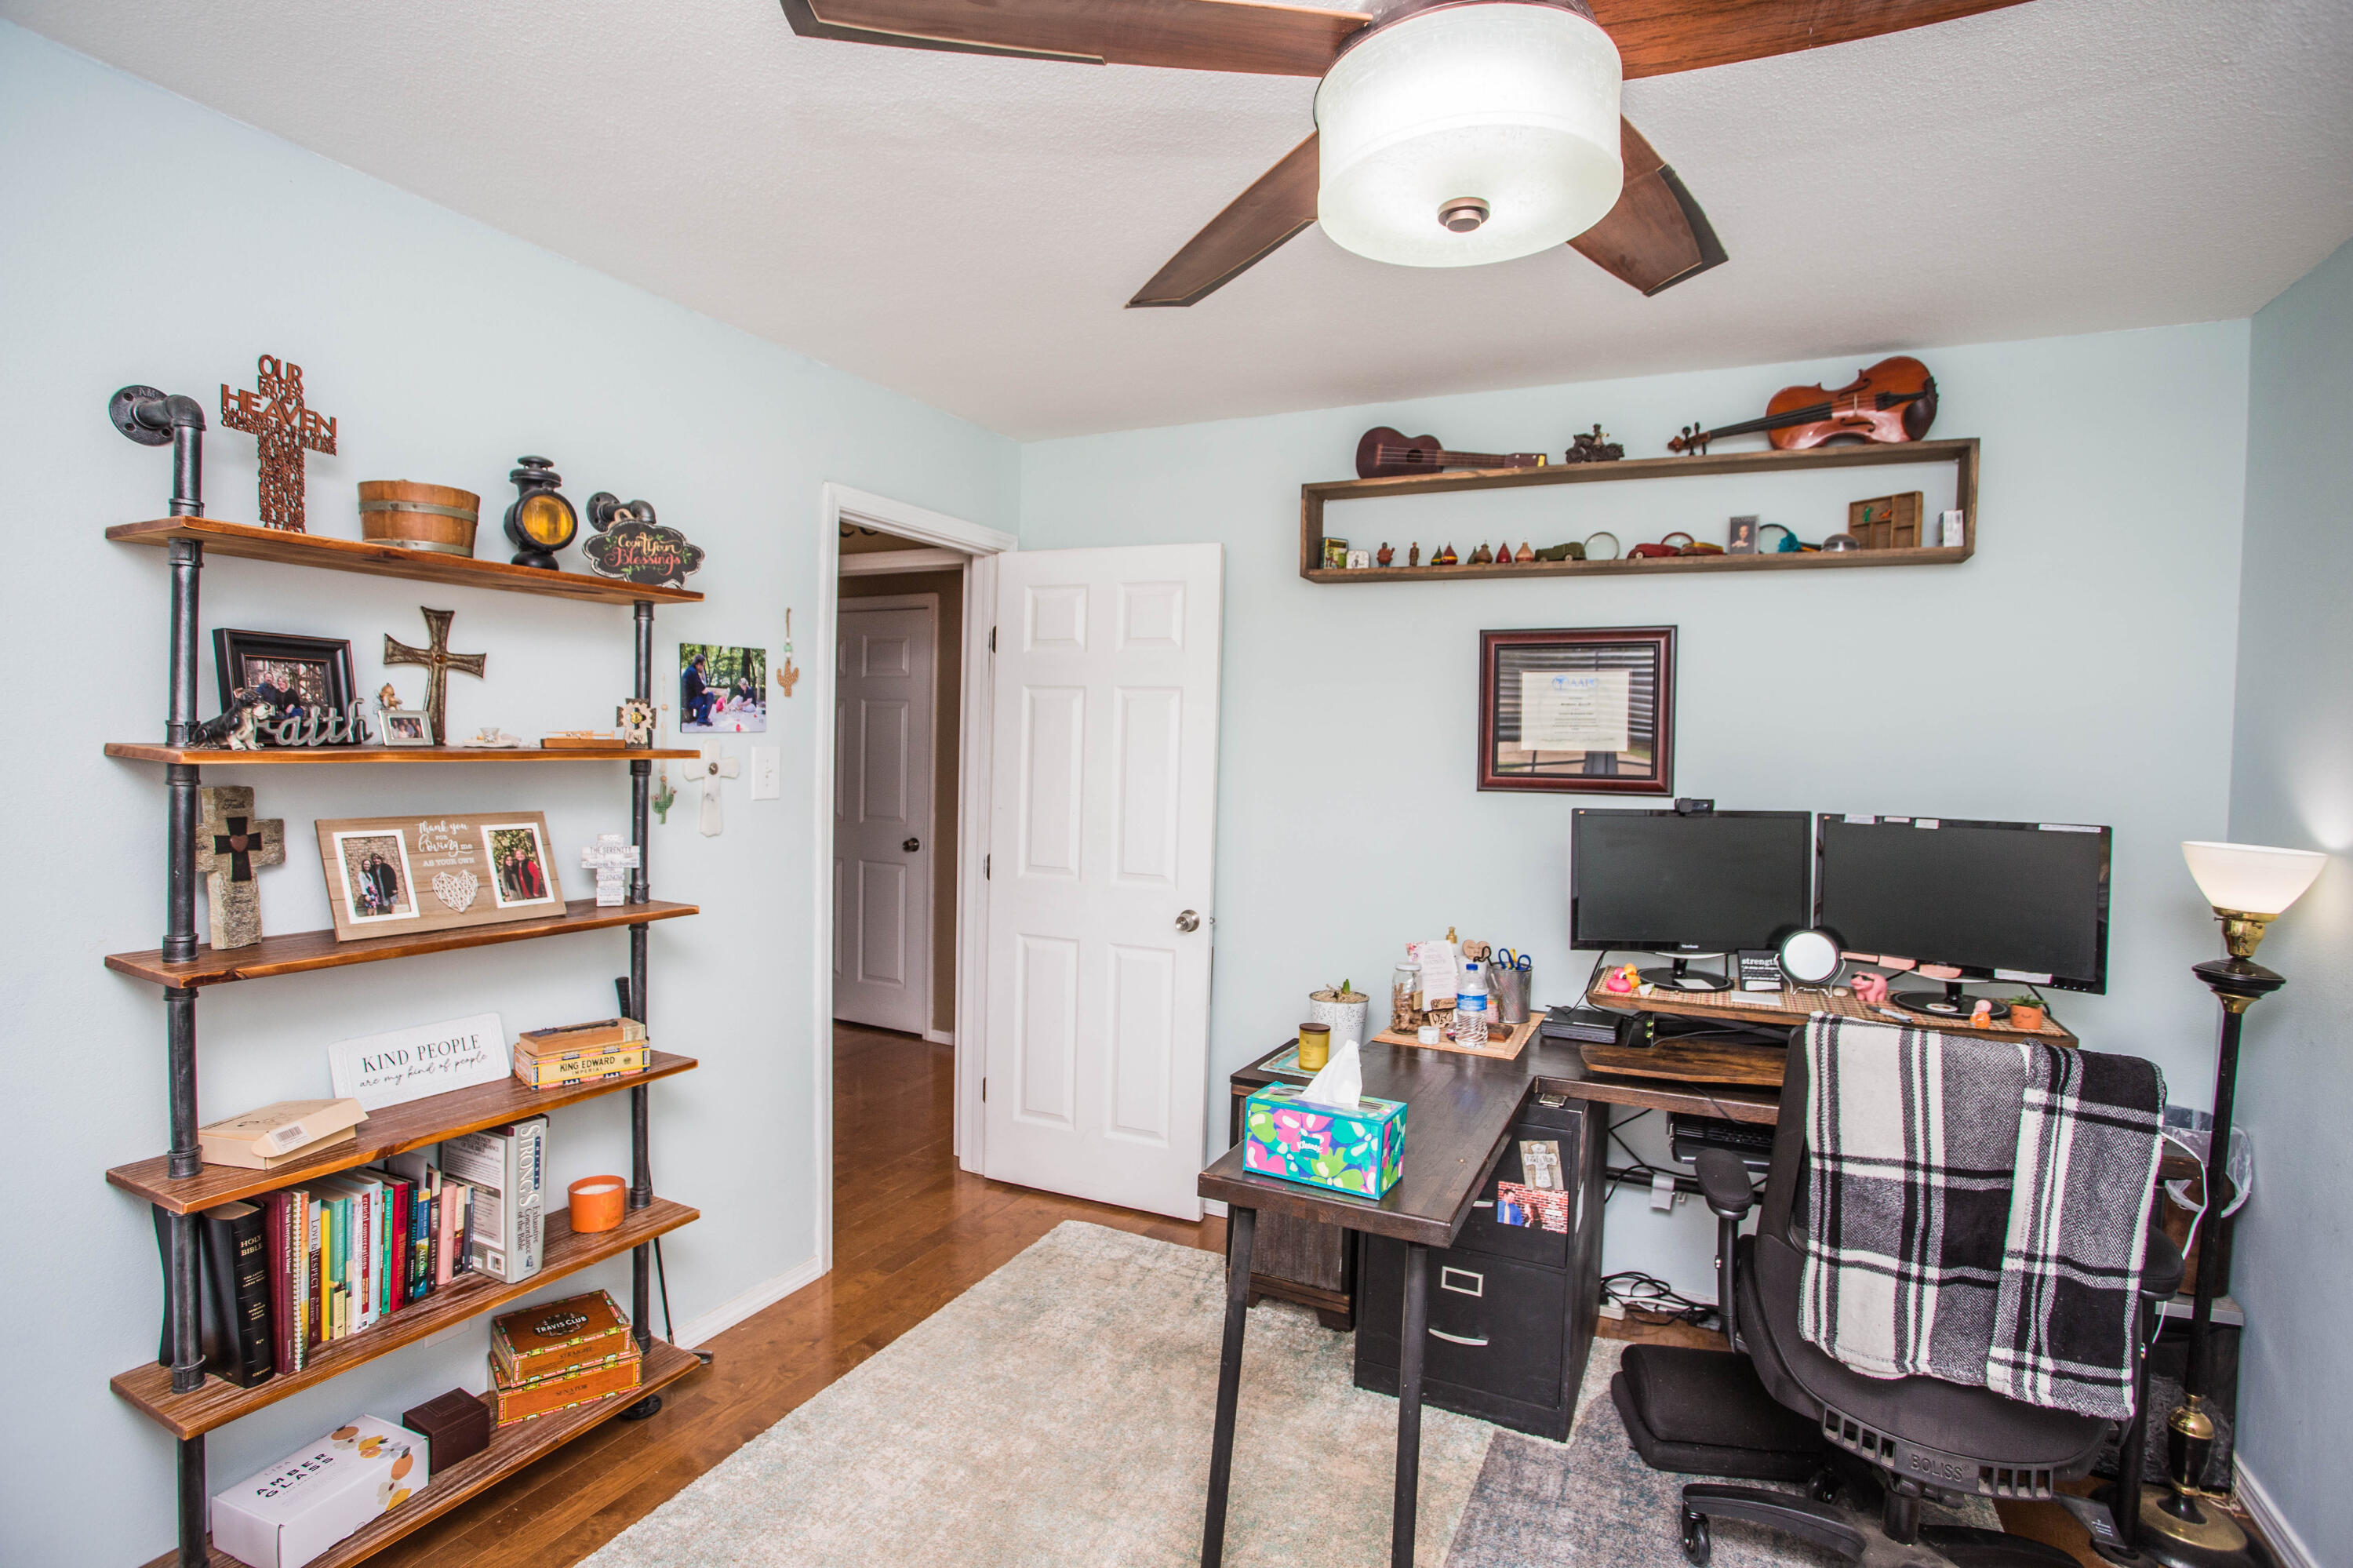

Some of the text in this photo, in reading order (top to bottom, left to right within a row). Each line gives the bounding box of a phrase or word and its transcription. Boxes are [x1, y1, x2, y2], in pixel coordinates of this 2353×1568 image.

[257, 354, 304, 390] OUR
[221, 383, 336, 438] HEAVEN
[604, 547, 681, 576] Blessings
[449, 823, 469, 835] you
[362, 1034, 482, 1073] KIND PEOPLE
[560, 1057, 616, 1072] KING EDWARD
[359, 1050, 489, 1087] are my kind of people
[1297, 1140, 1324, 1153] Kleenex
[240, 1235, 262, 1248] HOLY
[311, 1218, 320, 1242] LOVE
[518, 1233, 526, 1251] Bible
[241, 1243, 262, 1256] BIBLE
[311, 1249, 320, 1289] RESPECT
[535, 1315, 587, 1333] TRAVIS CLUB
[256, 1453, 326, 1495] AMBER
[265, 1457, 333, 1497] GLASS
[1911, 1454, 1962, 1483] BOLISS
